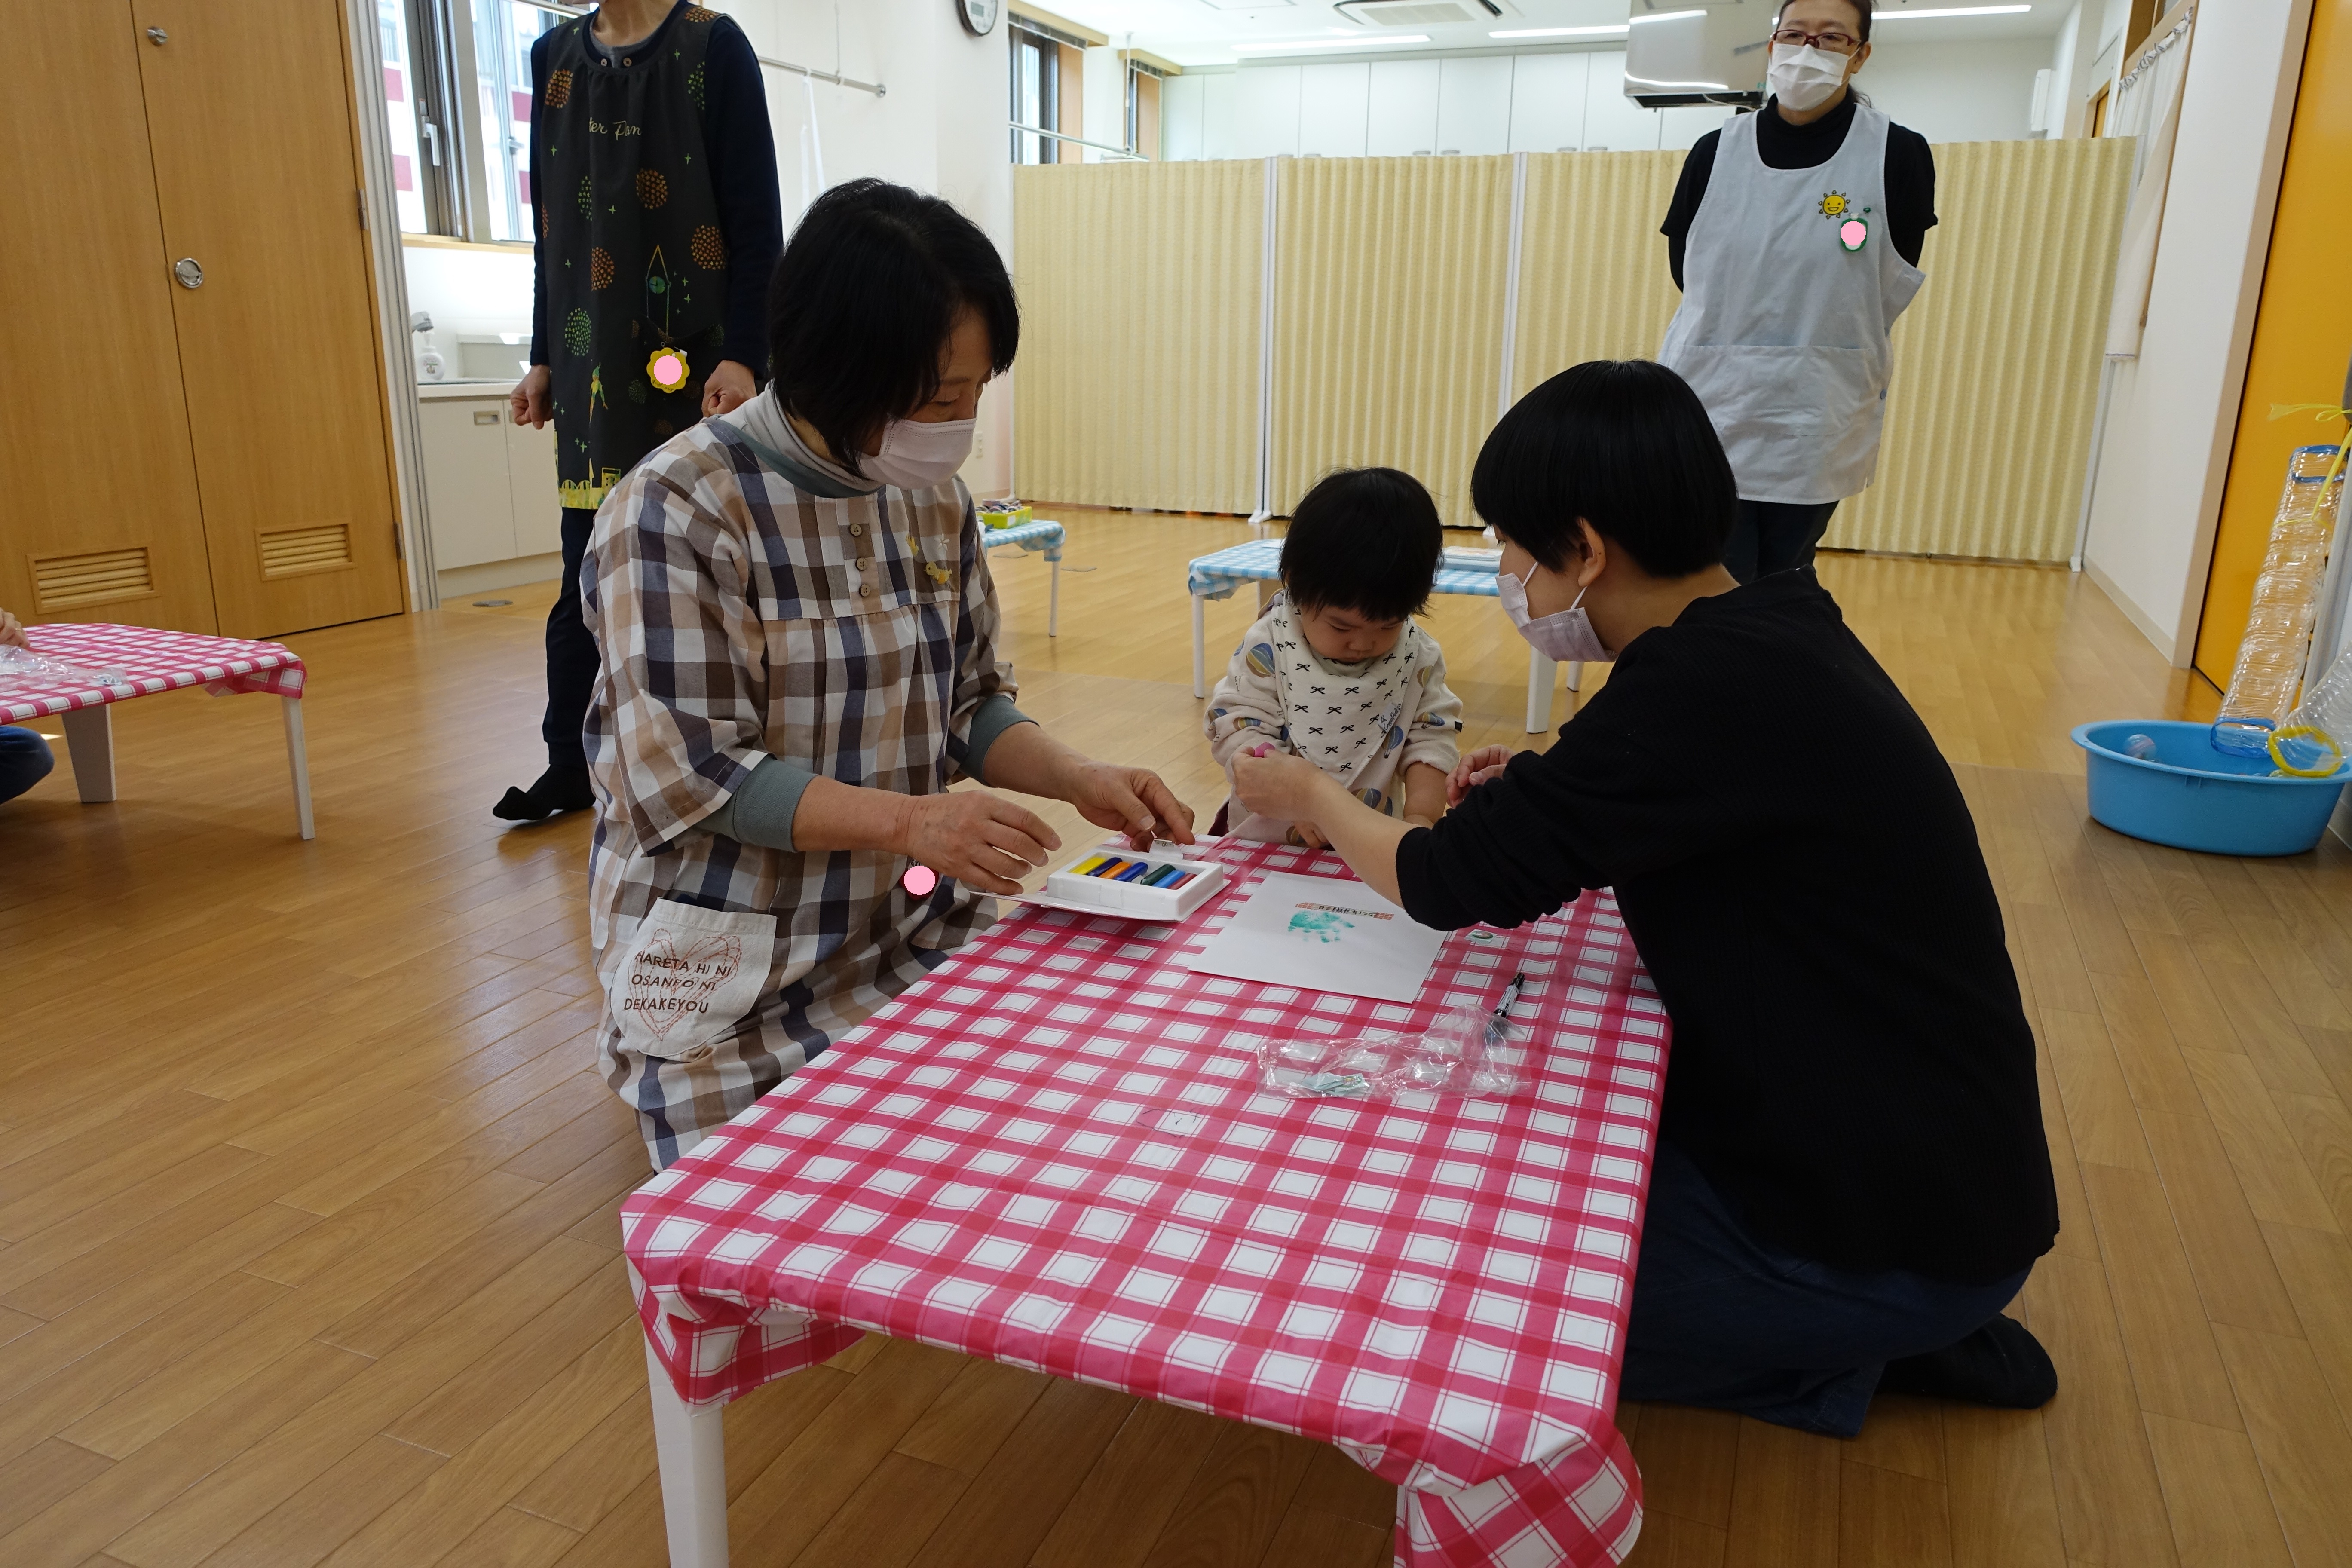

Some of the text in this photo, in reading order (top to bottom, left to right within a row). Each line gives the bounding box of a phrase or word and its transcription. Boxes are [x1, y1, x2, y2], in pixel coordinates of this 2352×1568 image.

[589, 116, 642, 141] ter Pan
[634, 950, 732, 977] HARETA HI NI
[631, 974, 716, 991] OSANPO NI
[624, 998, 709, 1014] DEKAKEYOU
